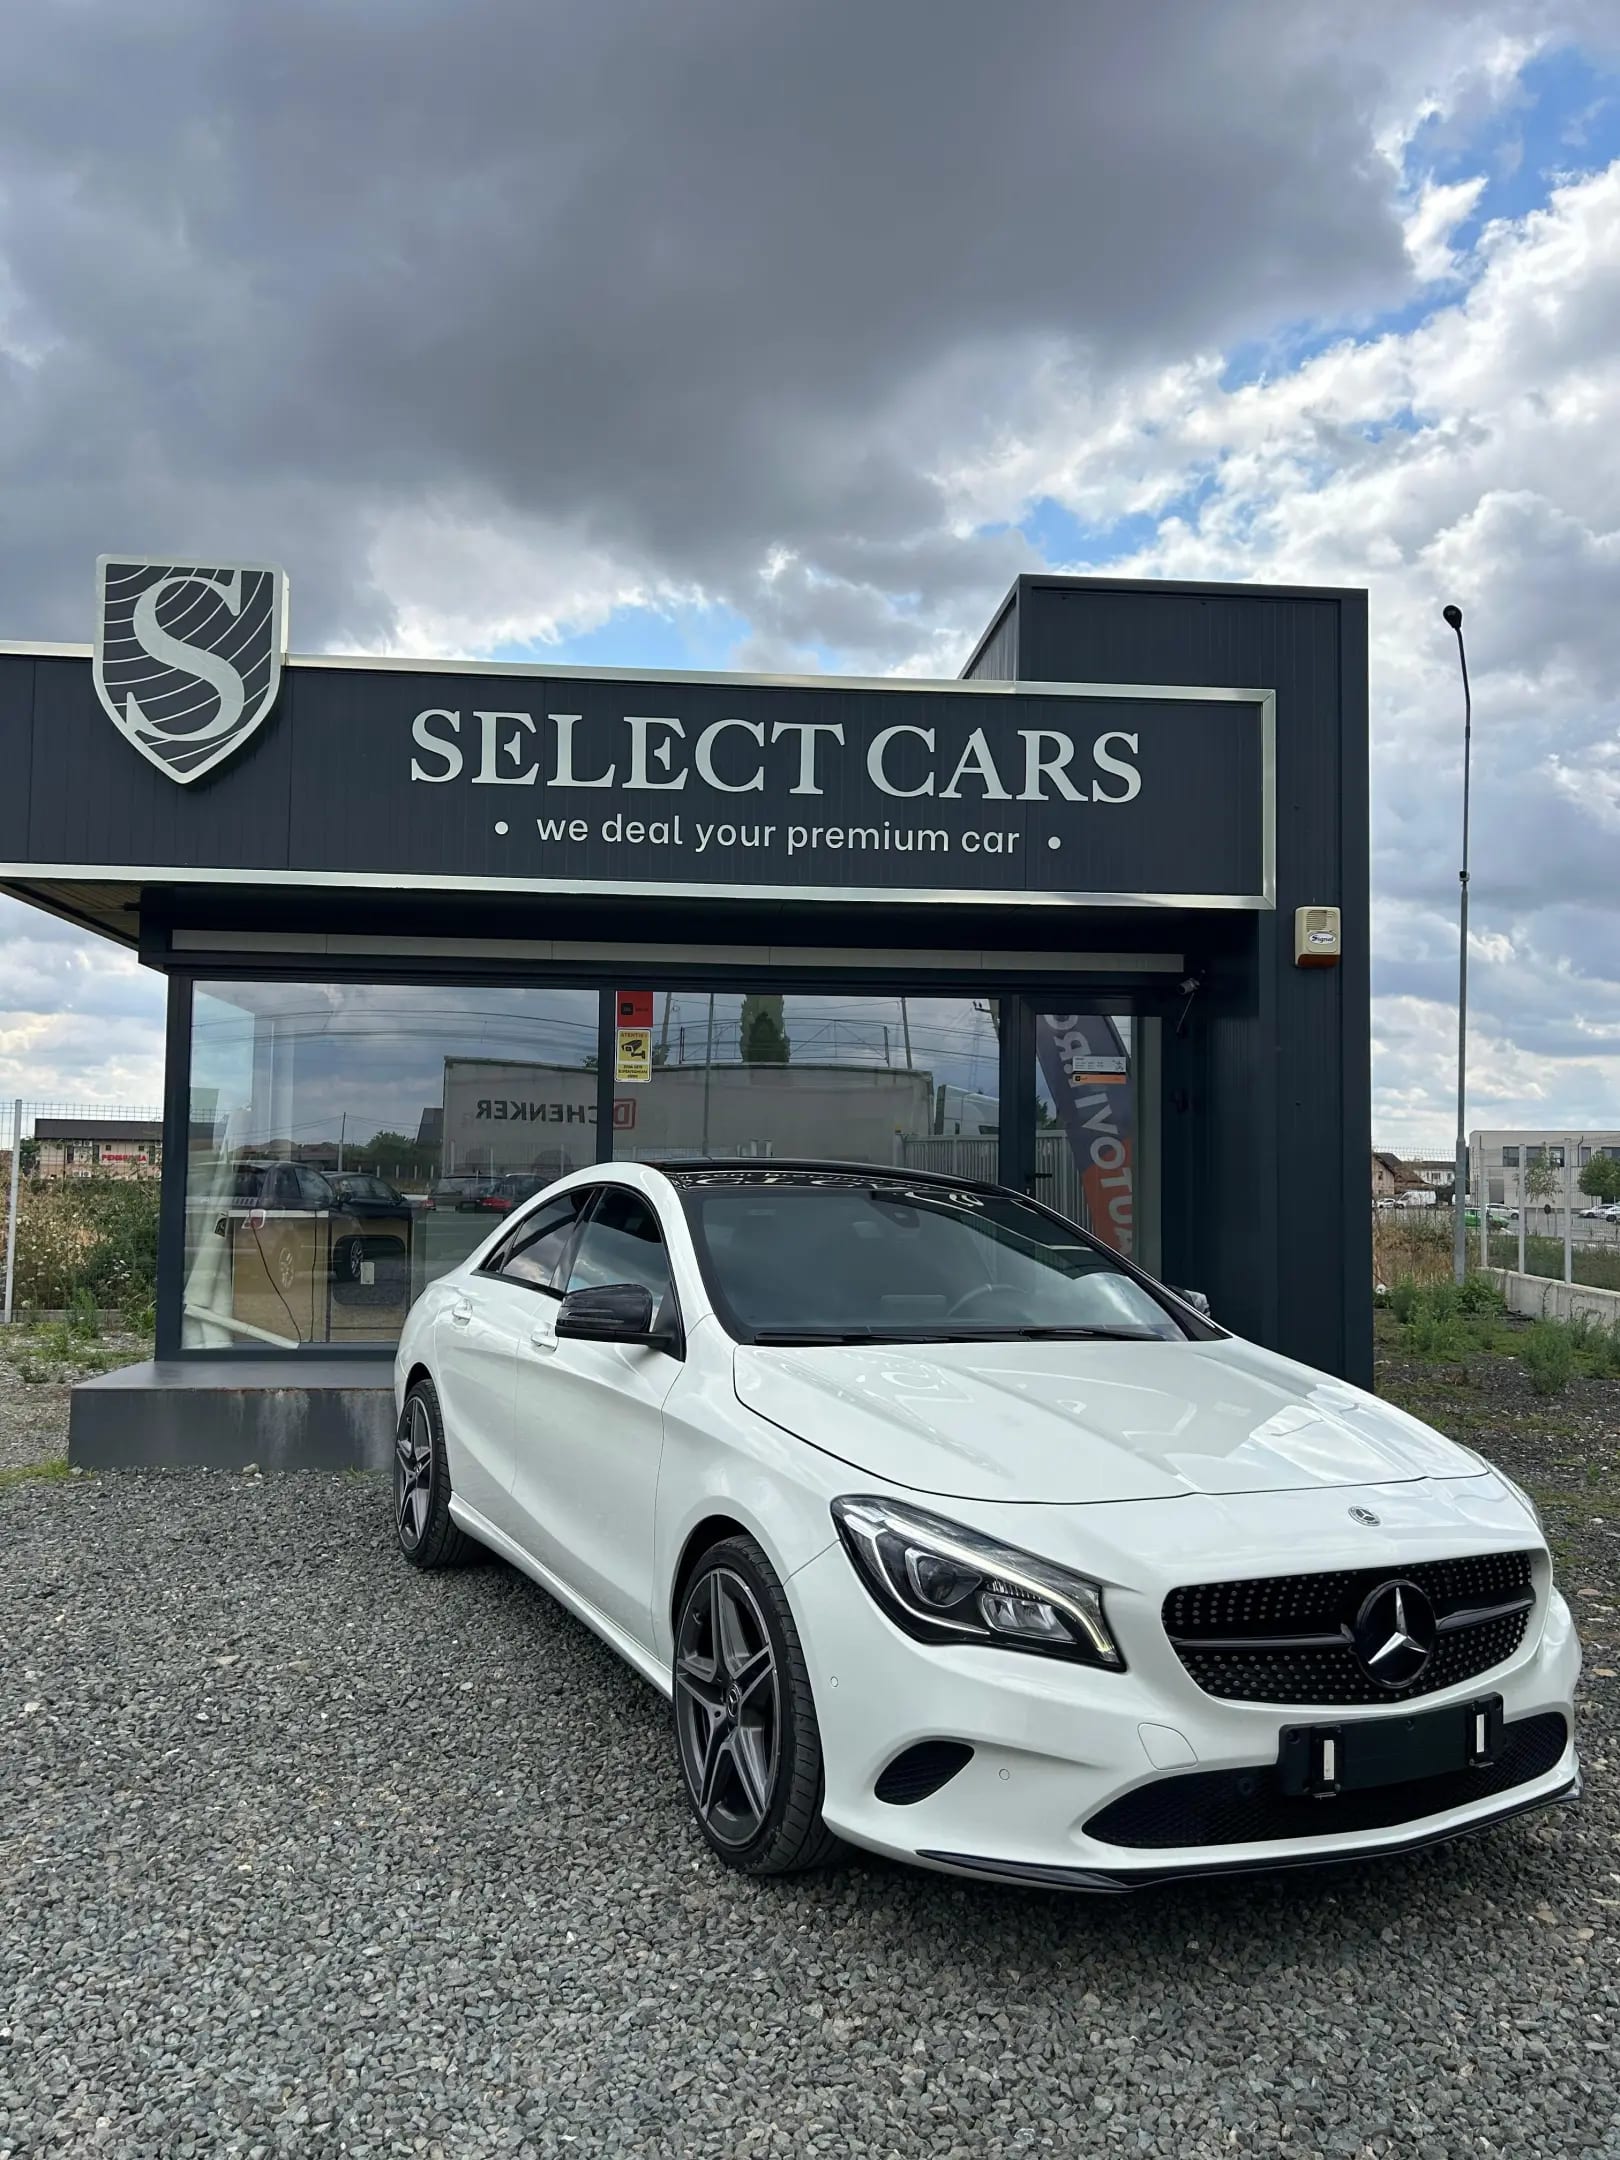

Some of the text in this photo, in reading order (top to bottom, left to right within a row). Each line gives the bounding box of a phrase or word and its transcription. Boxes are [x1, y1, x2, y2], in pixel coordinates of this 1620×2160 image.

[126, 569, 245, 742] S
[411, 708, 1142, 803] SELECT CARS
[536, 813, 1020, 856] we deal your premium car
